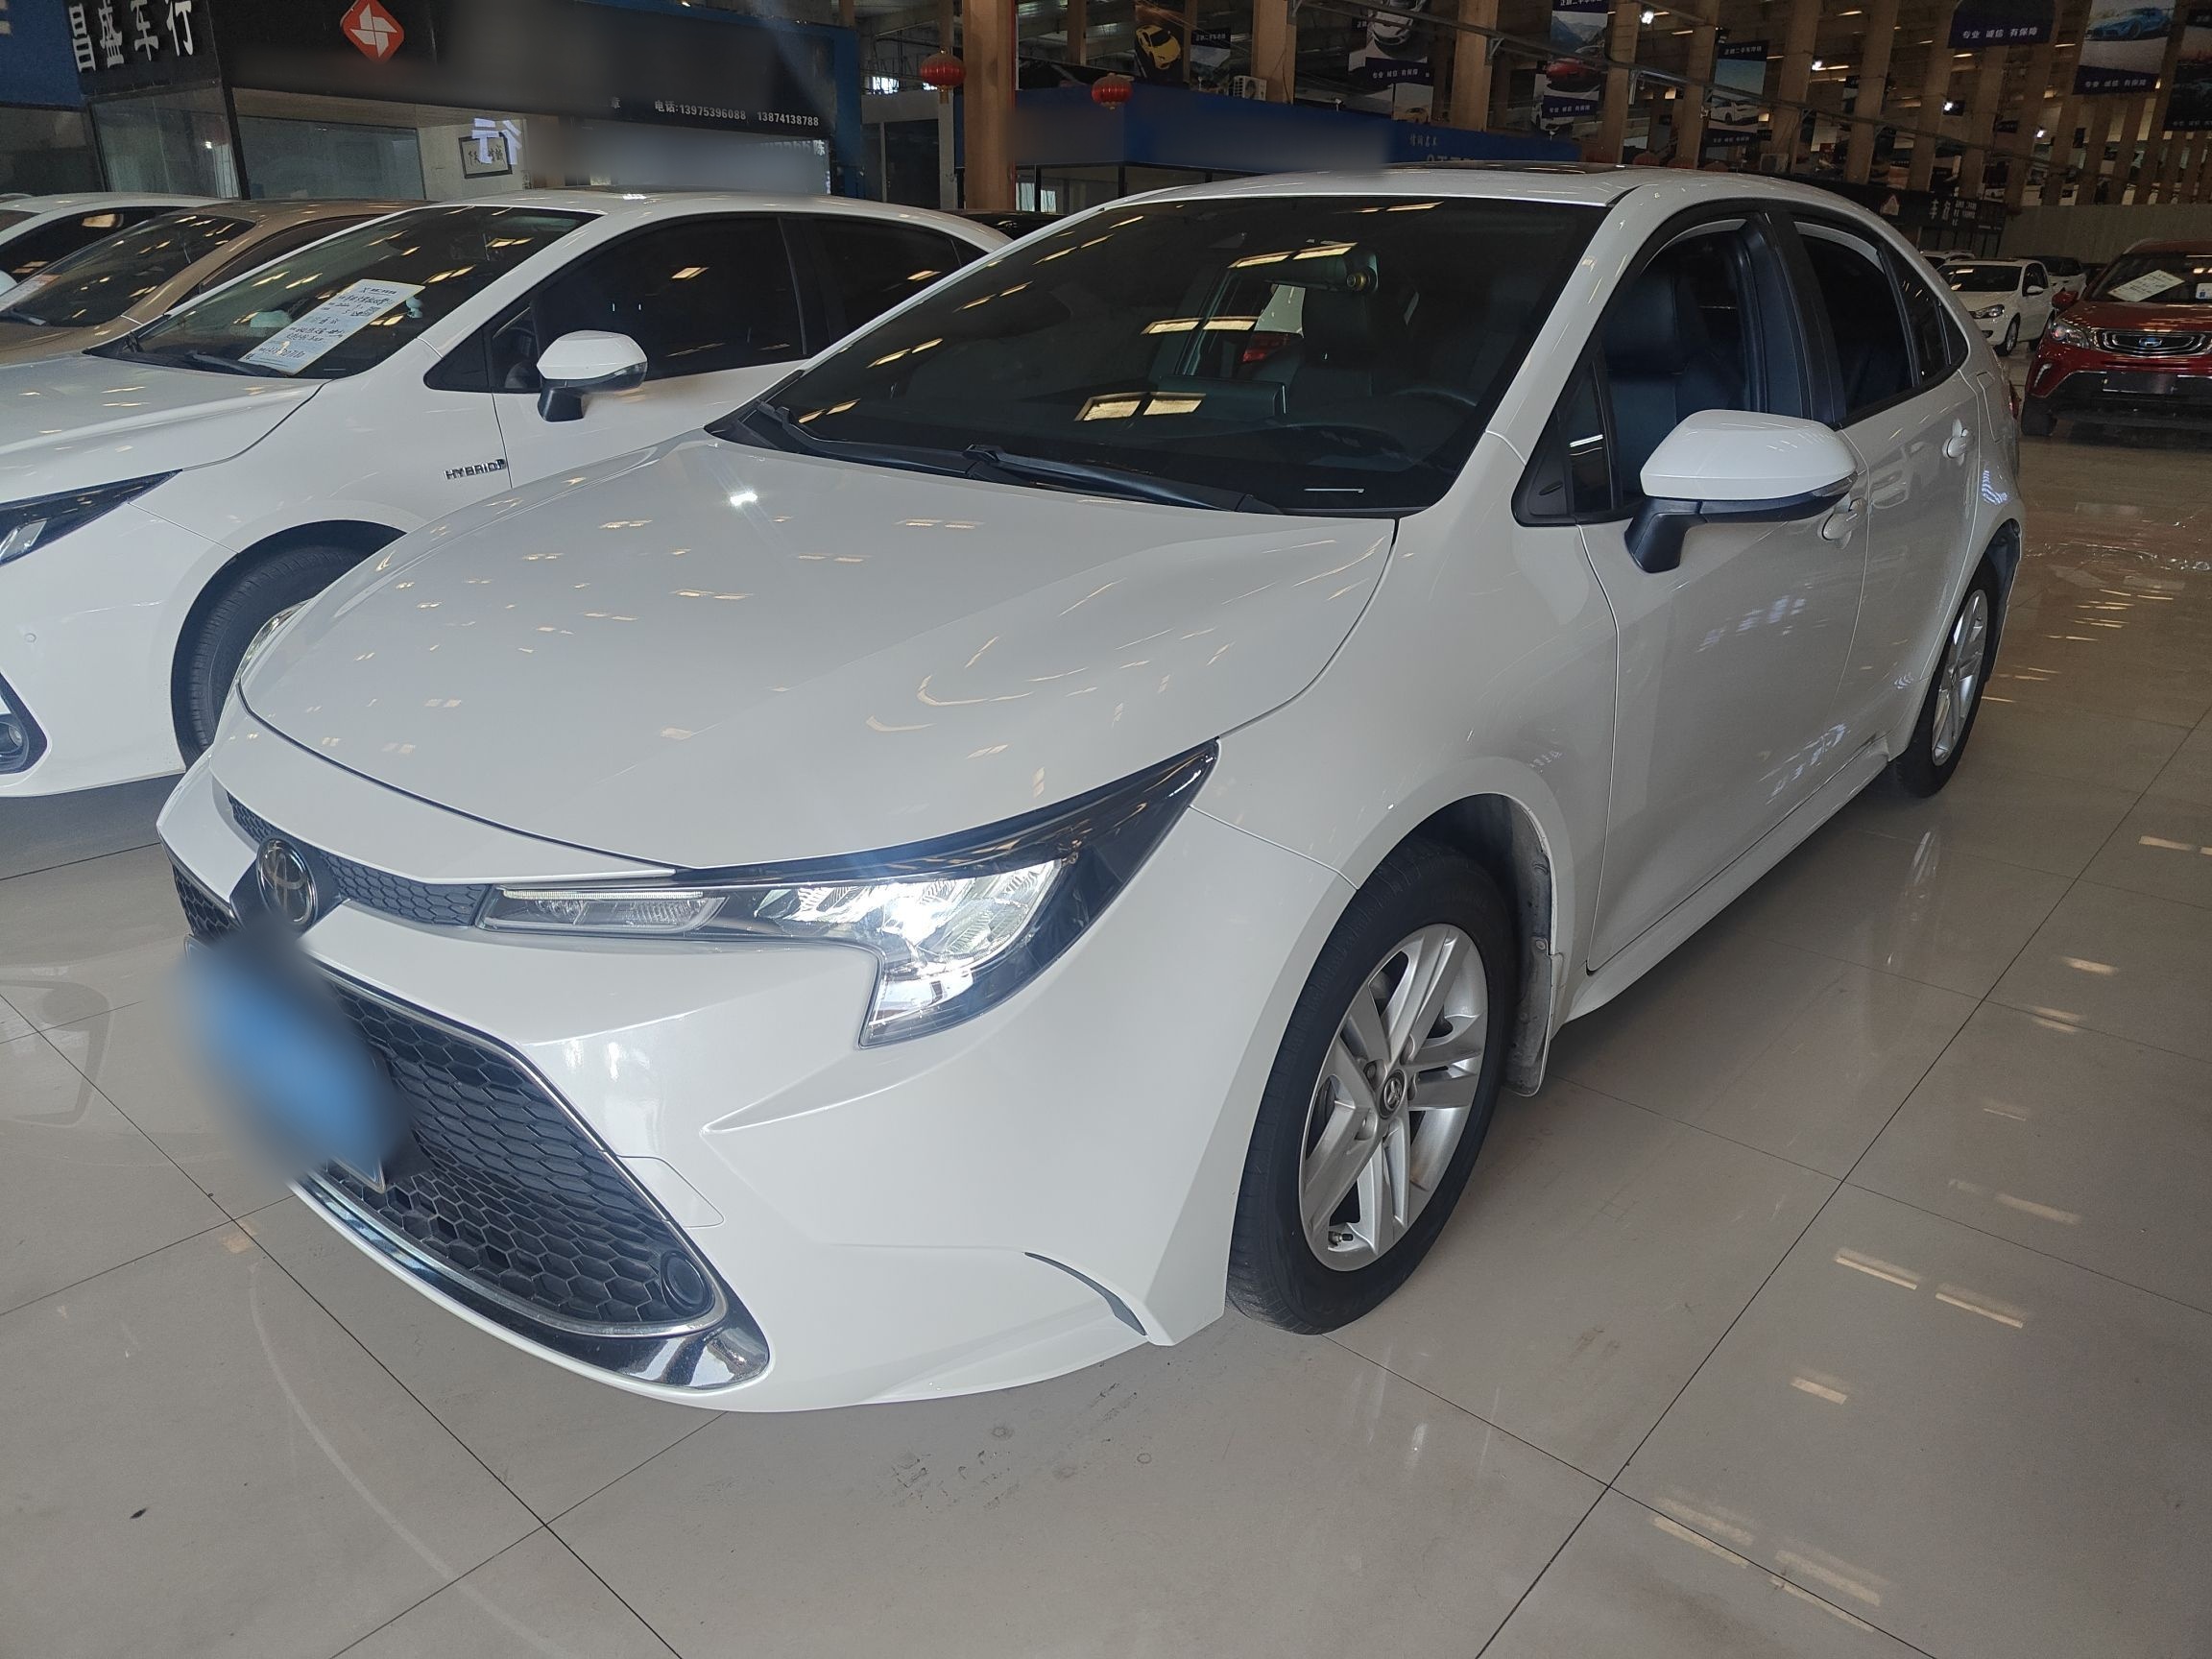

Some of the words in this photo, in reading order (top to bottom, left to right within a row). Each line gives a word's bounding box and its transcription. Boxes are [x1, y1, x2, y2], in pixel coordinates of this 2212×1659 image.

[68, 0, 193, 73] 昌盛车行
[757, 111, 820, 128] 13874138788
[445, 461, 499, 480] HYBRID
